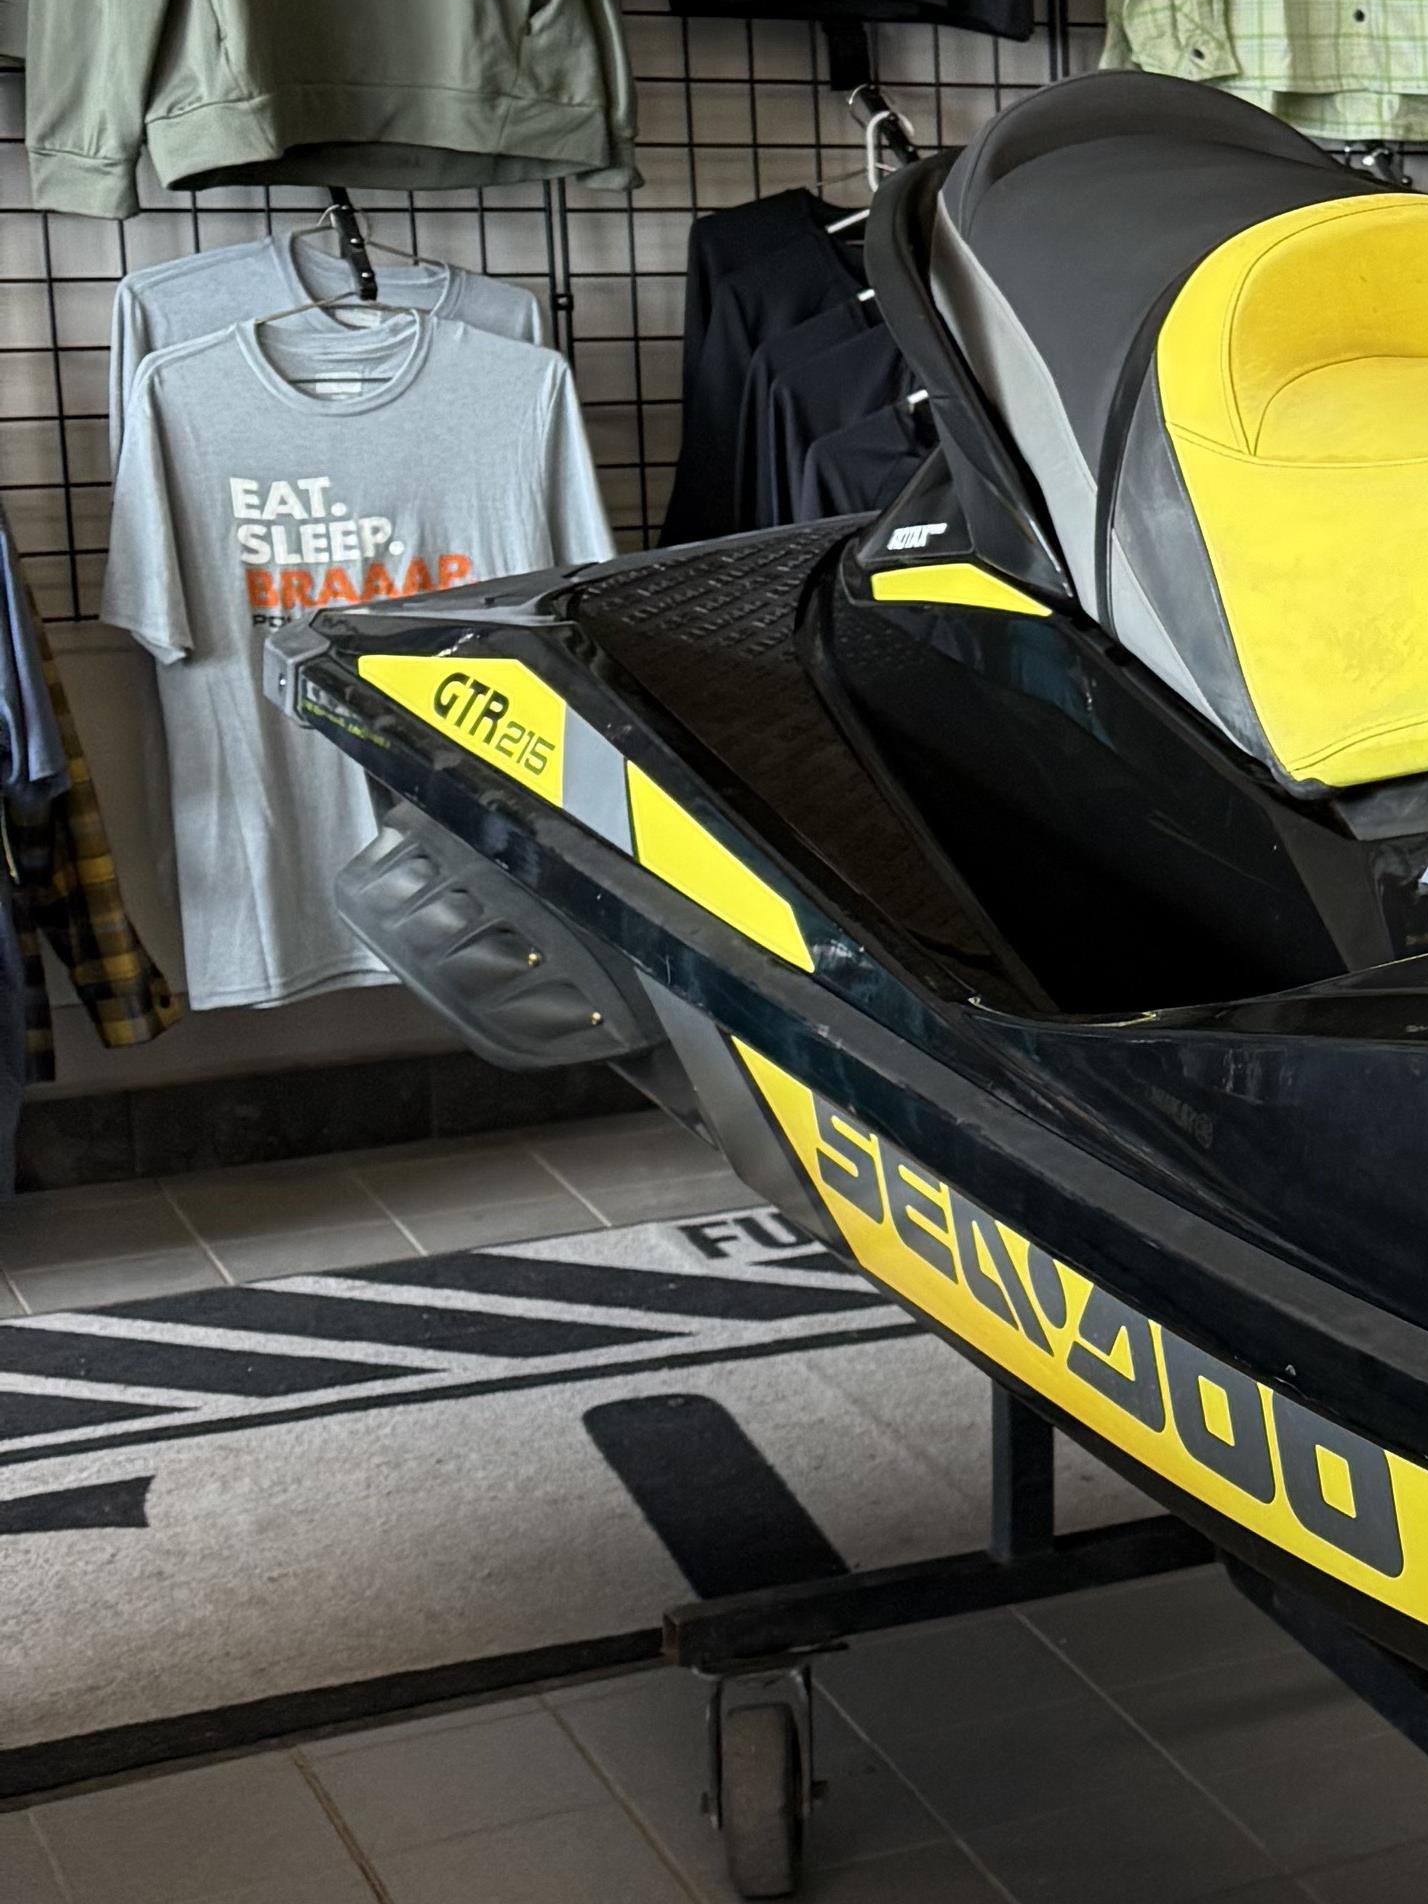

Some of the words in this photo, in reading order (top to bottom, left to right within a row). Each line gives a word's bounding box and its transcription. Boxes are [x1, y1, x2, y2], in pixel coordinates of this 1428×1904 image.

[230, 474, 347, 520] EAT.
[237, 516, 405, 565] SLEEP.
[433, 672, 510, 744] GTR
[498, 723, 557, 777] 215
[677, 1212, 818, 1260] FU
